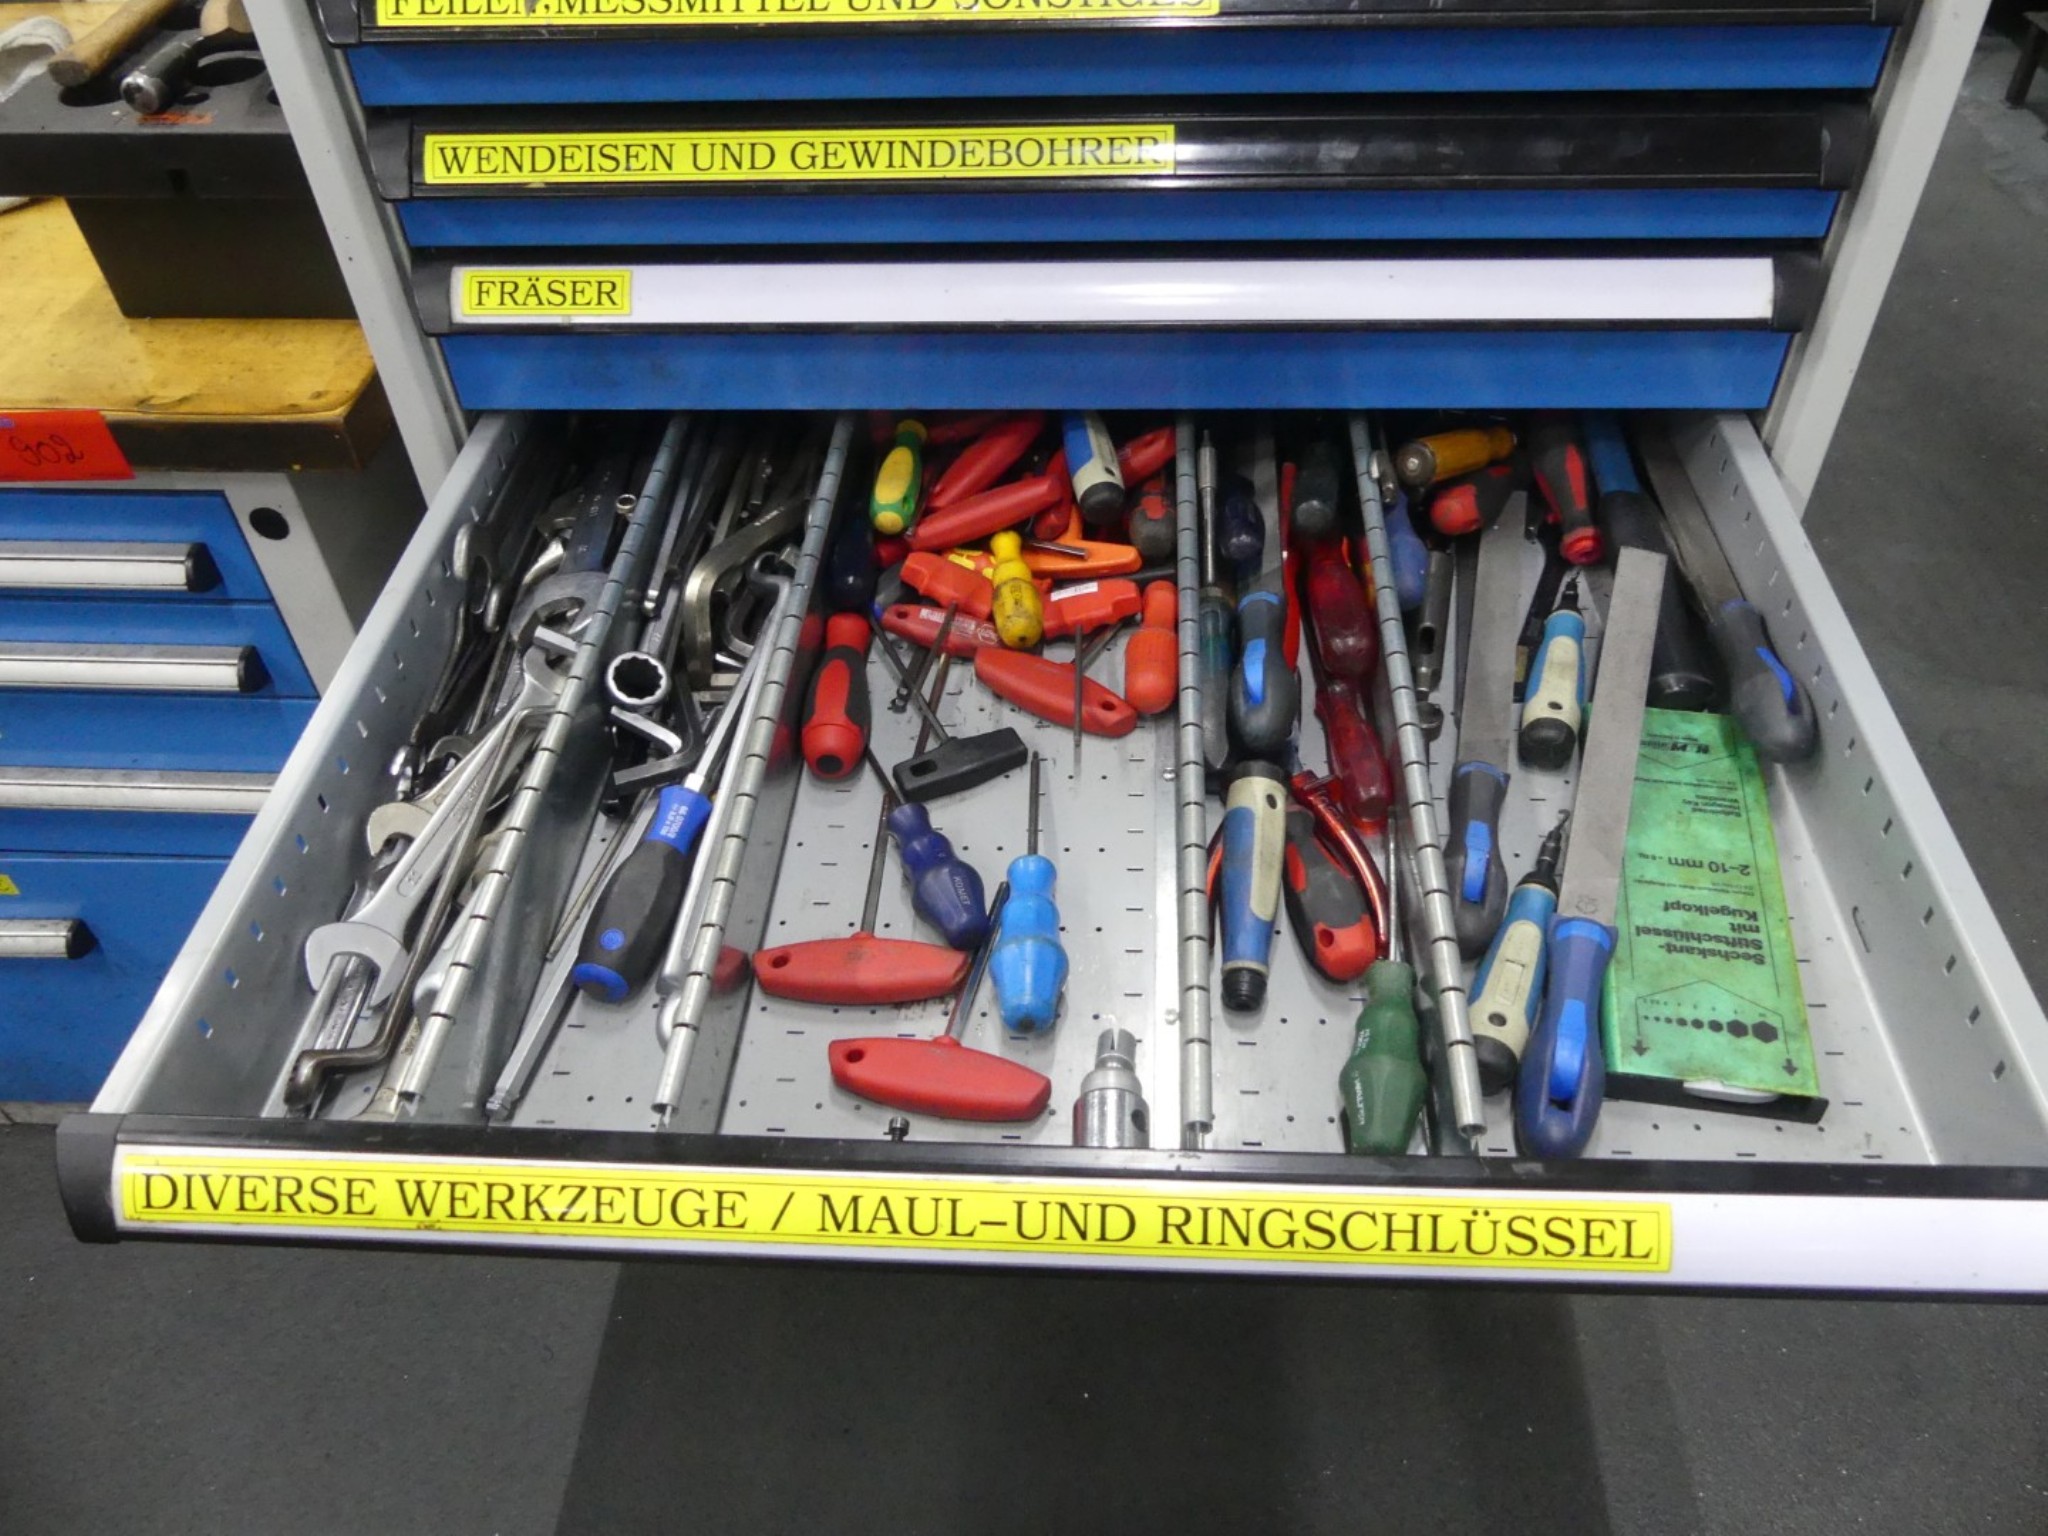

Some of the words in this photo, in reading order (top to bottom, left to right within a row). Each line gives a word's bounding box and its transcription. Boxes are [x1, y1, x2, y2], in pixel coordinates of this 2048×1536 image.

[438, 143, 675, 174] WENDEISEN
[691, 142, 776, 171] UND
[790, 135, 1161, 170] GEWINDEBOHRER
[475, 277, 618, 306] FRÄSER
[1668, 857, 1703, 869] mm
[1664, 900, 1758, 922] Kugelkopf
[1636, 925, 1763, 950] Stiftschlüssel
[1729, 922, 1760, 933] mit
[1658, 941, 1766, 965] Sechskant-
[142, 1173, 377, 1216] DIVERSE
[396, 1179, 748, 1229] WERKZEUGE
[770, 1191, 795, 1231] /
[1157, 1204, 1652, 1259] RINGSCHLÜSSEL
